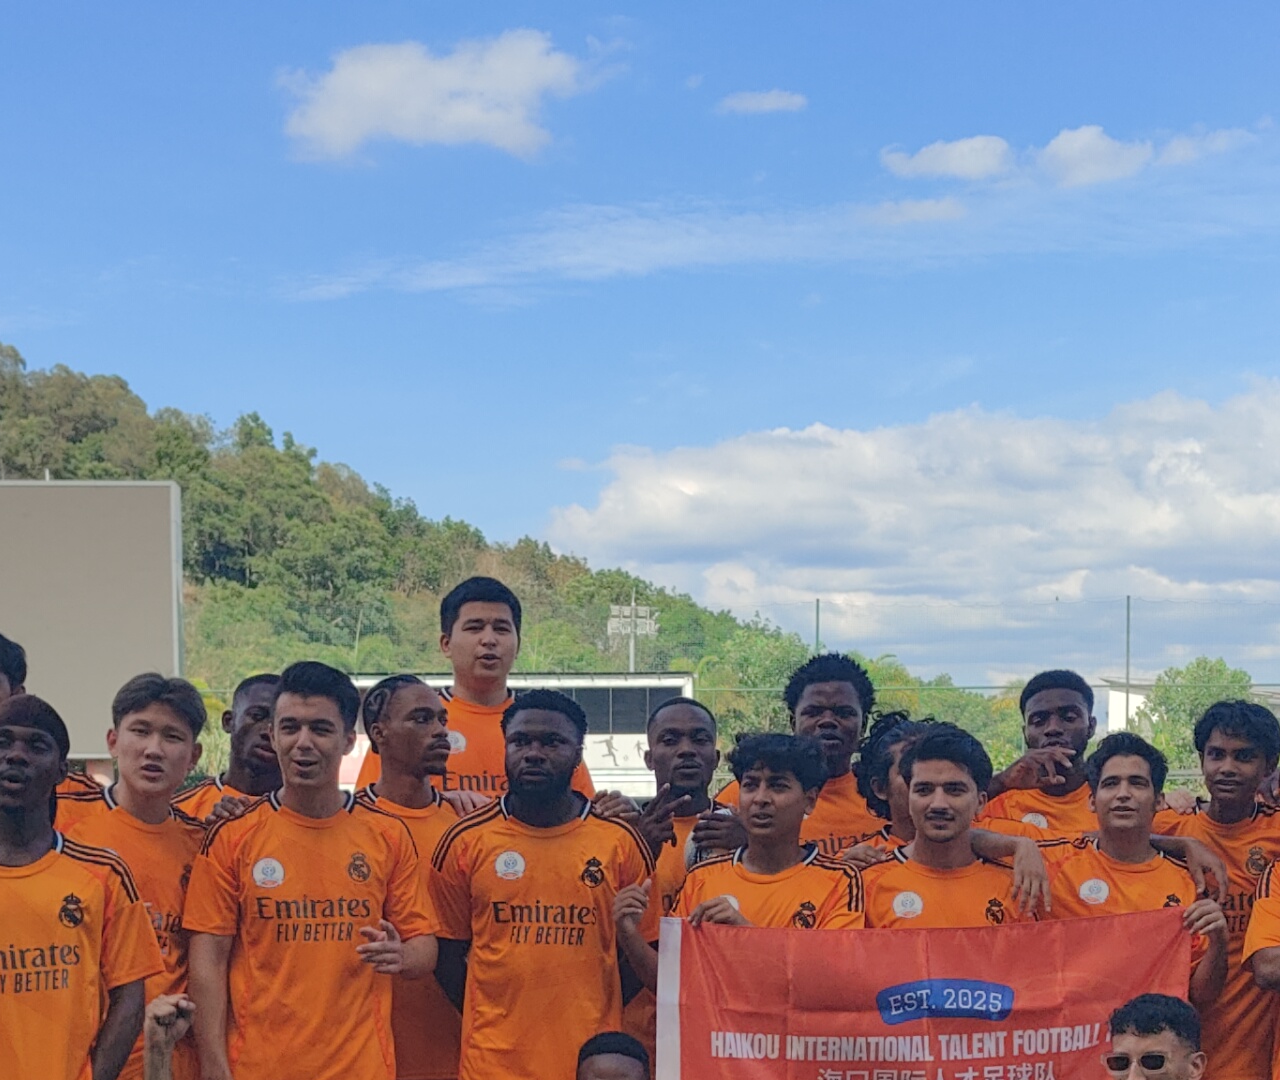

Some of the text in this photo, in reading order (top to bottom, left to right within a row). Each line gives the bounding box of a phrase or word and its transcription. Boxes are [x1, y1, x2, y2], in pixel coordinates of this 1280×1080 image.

[443, 770, 509, 791] Emira
[256, 894, 371, 919] Emirates
[491, 900, 598, 926] Emirates
[276, 922, 354, 943] FLY BETTER
[509, 925, 585, 946] FLY BETTER
[13, 968, 69, 994] BETTER
[888, 988, 1003, 1016] EST. 2025
[710, 1030, 780, 1060] HAIKOU
[785, 1033, 935, 1063] INTERNATIONAL
[938, 1030, 1007, 1062] TALENT
[1013, 1022, 1100, 1057] FOOTBALL
